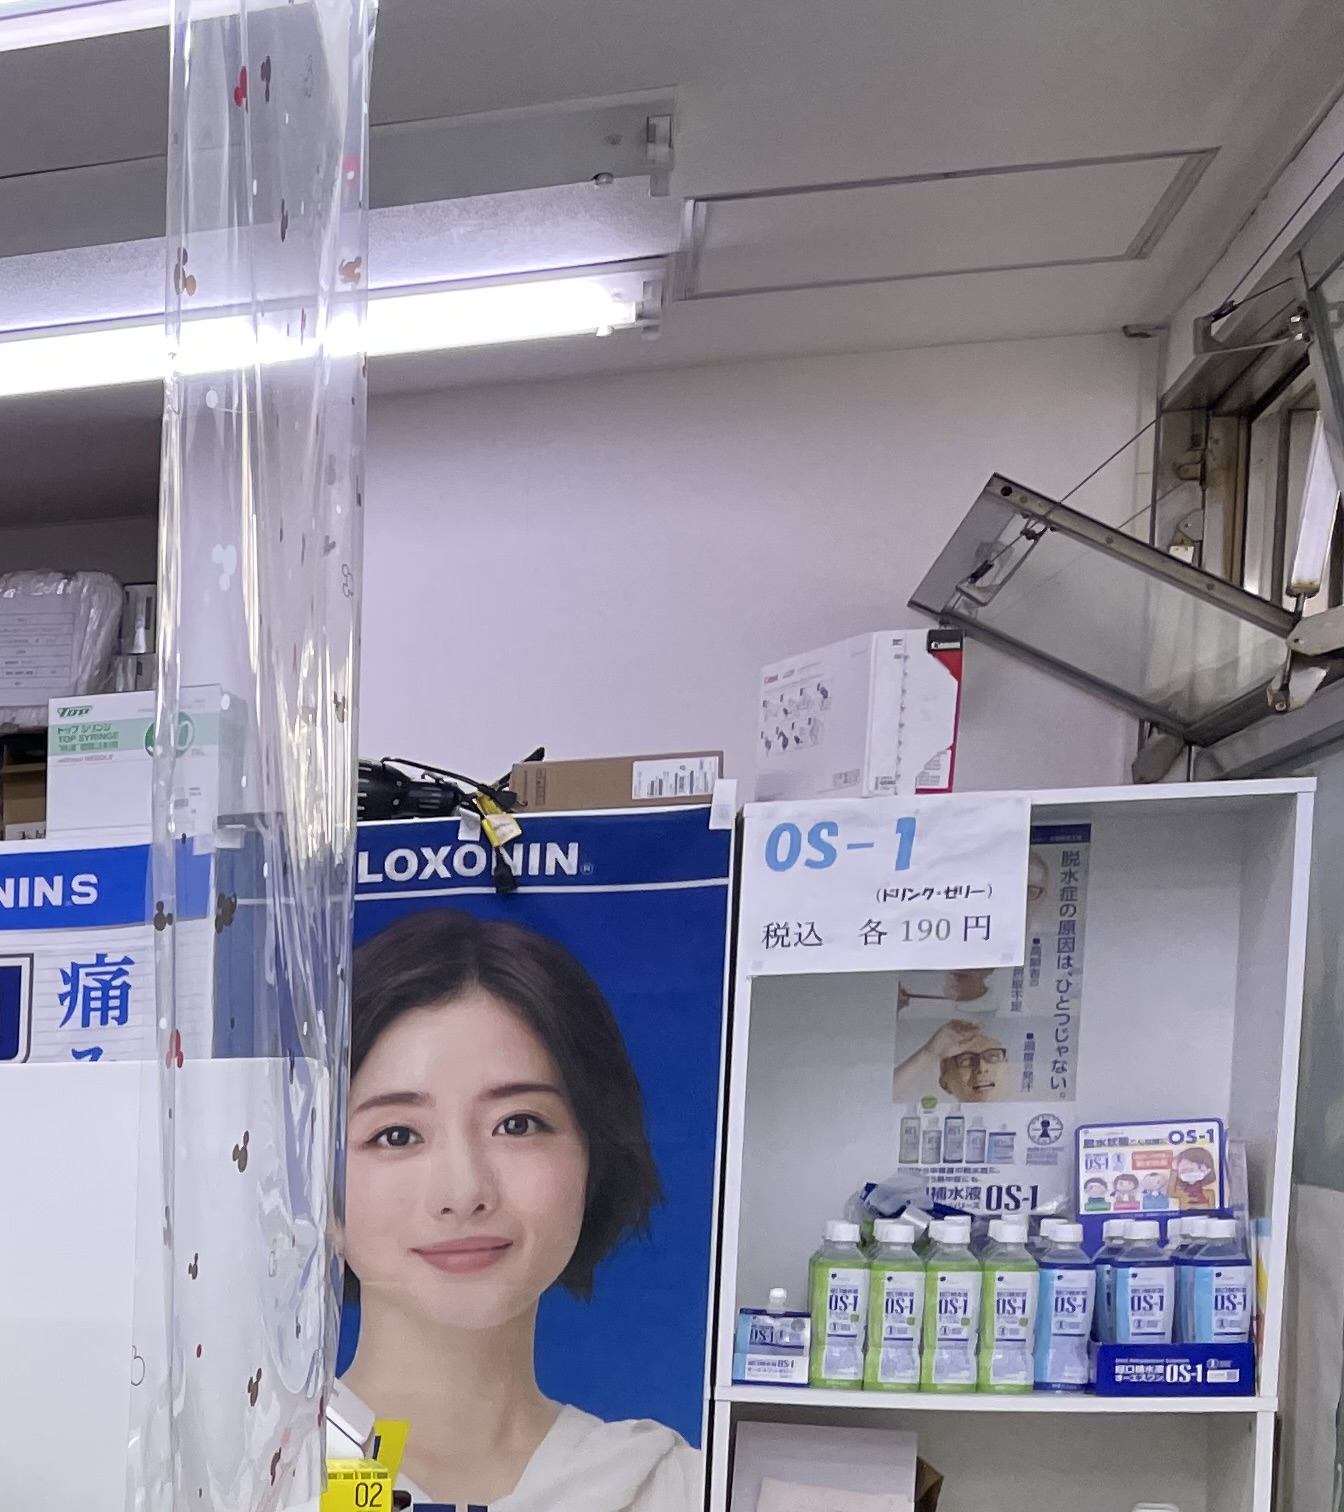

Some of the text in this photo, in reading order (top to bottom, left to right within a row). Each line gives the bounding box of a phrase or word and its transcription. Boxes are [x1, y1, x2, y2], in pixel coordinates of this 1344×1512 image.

[765, 817, 917, 872] OS-1
[761, 920, 824, 951] 税込
[1050, 850, 1081, 1099] 脱水症の原因は、ひとつじゃない。
[1167, 1128, 1215, 1146] OS-1
[986, 1183, 1039, 1213] OS-1
[1165, 1363, 1203, 1383] OS-1
[355, 1482, 383, 1508] 02
